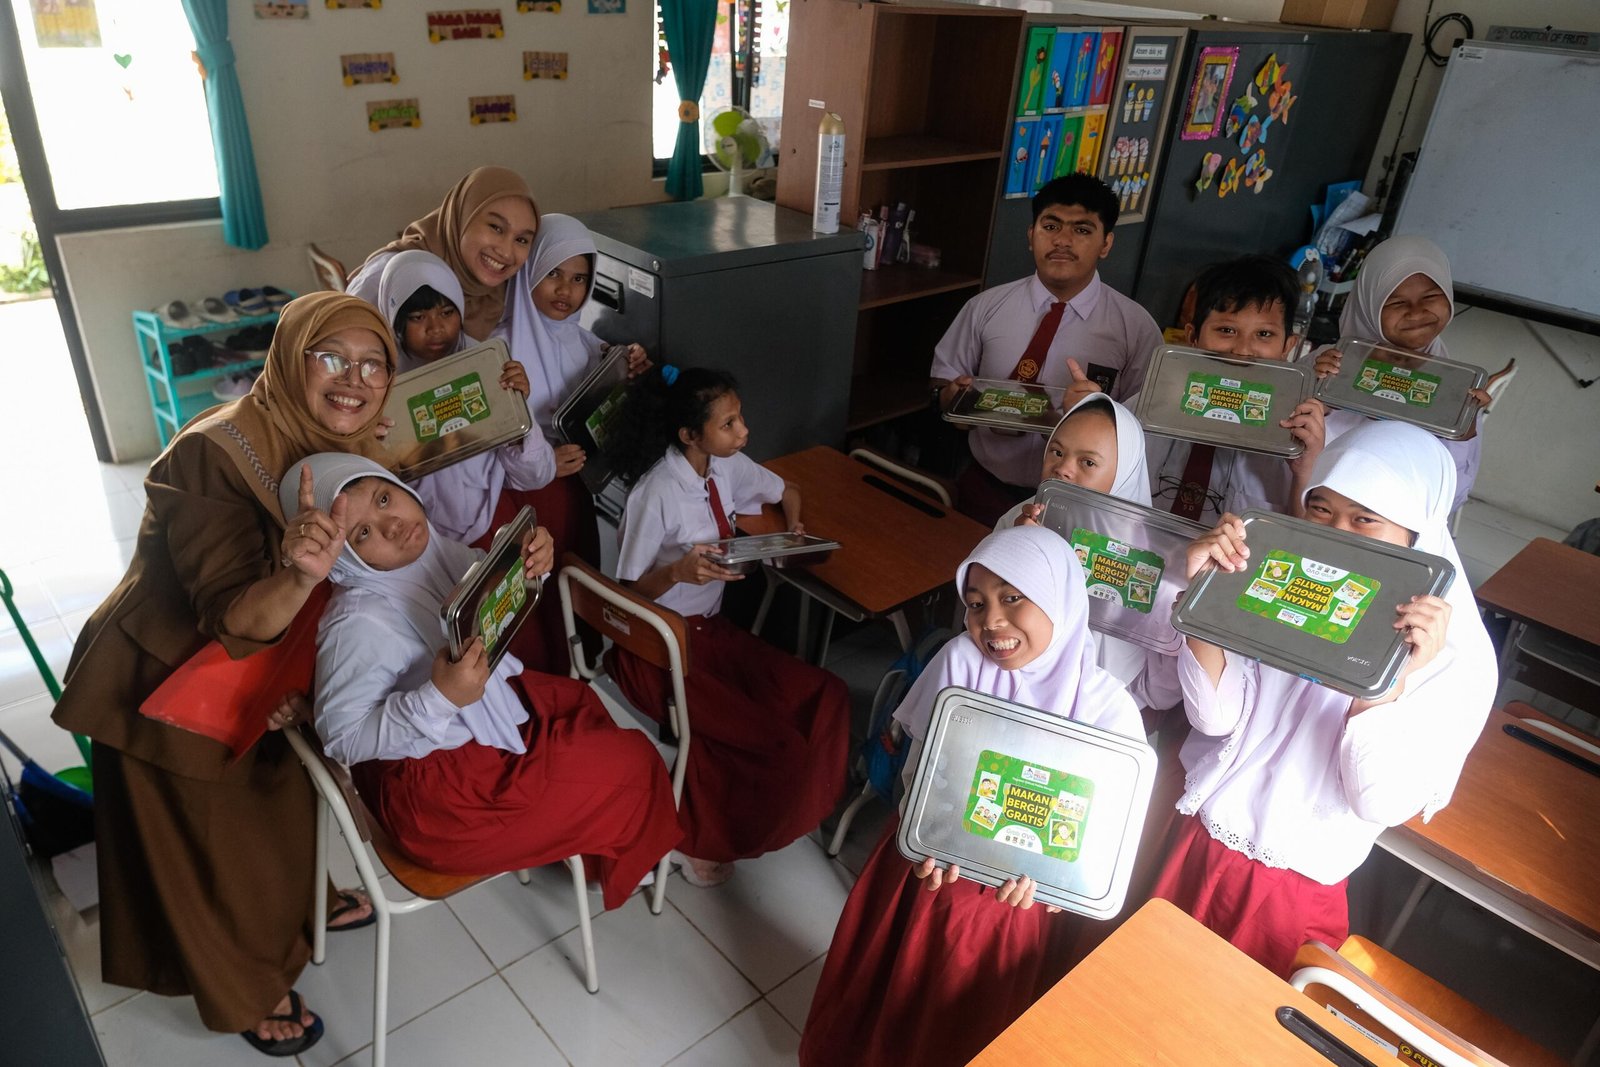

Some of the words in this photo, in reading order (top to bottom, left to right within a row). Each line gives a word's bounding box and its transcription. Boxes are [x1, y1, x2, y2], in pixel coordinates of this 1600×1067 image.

[1510, 30, 1549, 43] COGNITION
[1552, 32, 1563, 43] OF
[1562, 33, 1589, 46] FRUITS
[1211, 394, 1242, 404] BERGIZI
[1213, 389, 1242, 399] MAKAN
[434, 396, 459, 410] MAKAN
[1211, 400, 1240, 410] GRATIS
[1095, 563, 1128, 579] BERGIZI
[1098, 556, 1129, 571] MAKAN
[1094, 572, 1124, 587] GRATIS
[1294, 577, 1332, 594] GRATIS
[1283, 594, 1323, 612] MAKAN
[1287, 586, 1329, 604] BERGIZI
[1010, 787, 1050, 805] MAKAN
[1007, 797, 1048, 816] BERGIZI
[1006, 809, 1044, 827] GRATIS
[1021, 832, 1036, 841] OVO
